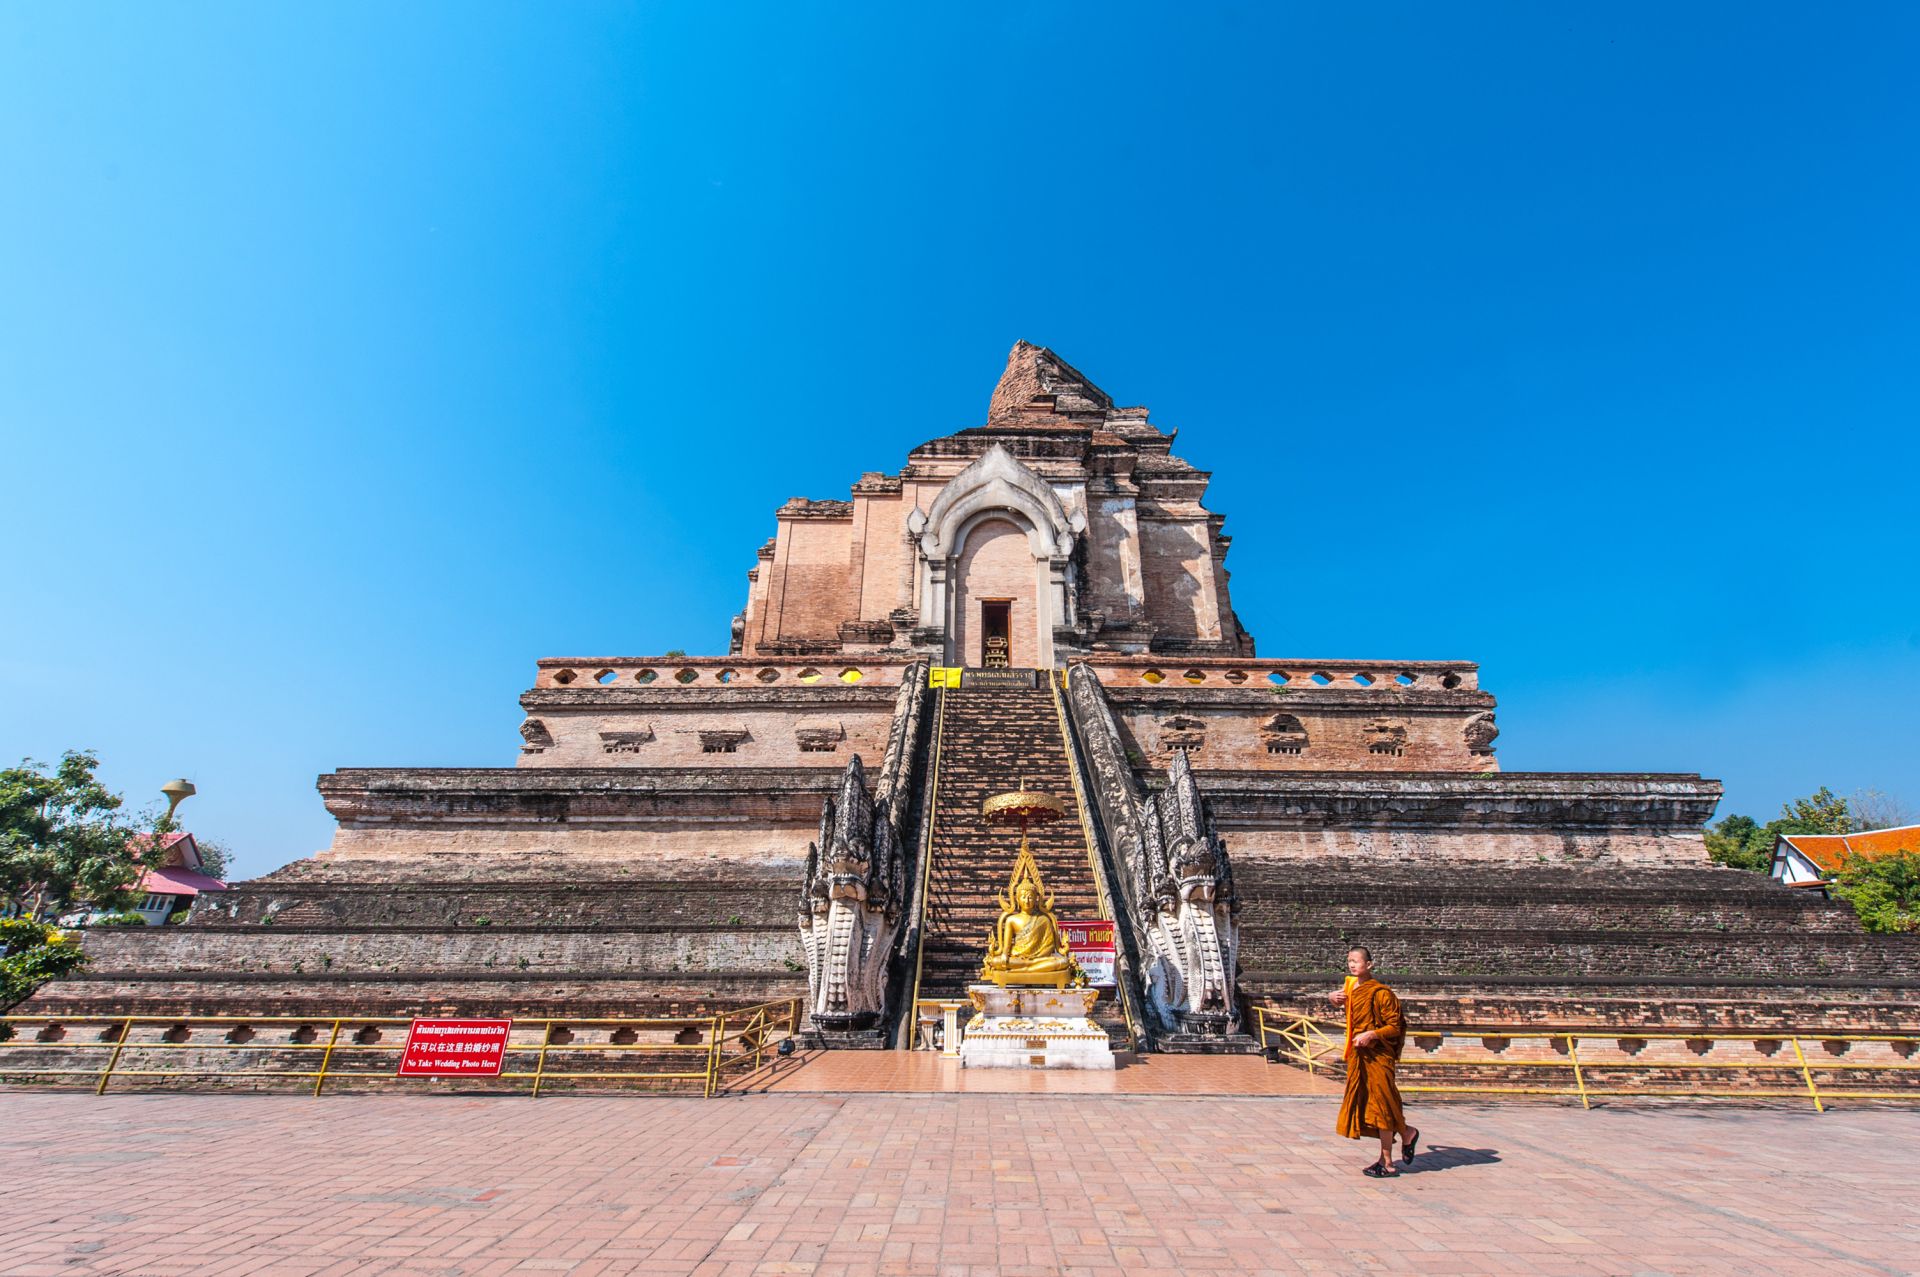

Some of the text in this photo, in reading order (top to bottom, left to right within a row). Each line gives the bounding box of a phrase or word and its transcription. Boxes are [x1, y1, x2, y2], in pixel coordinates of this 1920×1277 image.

[1068, 928, 1087, 945] Entry
[411, 1042, 500, 1053] 不可以在这里拍婚纱照
[407, 1059, 497, 1069] No Take Wedding Photo Here
